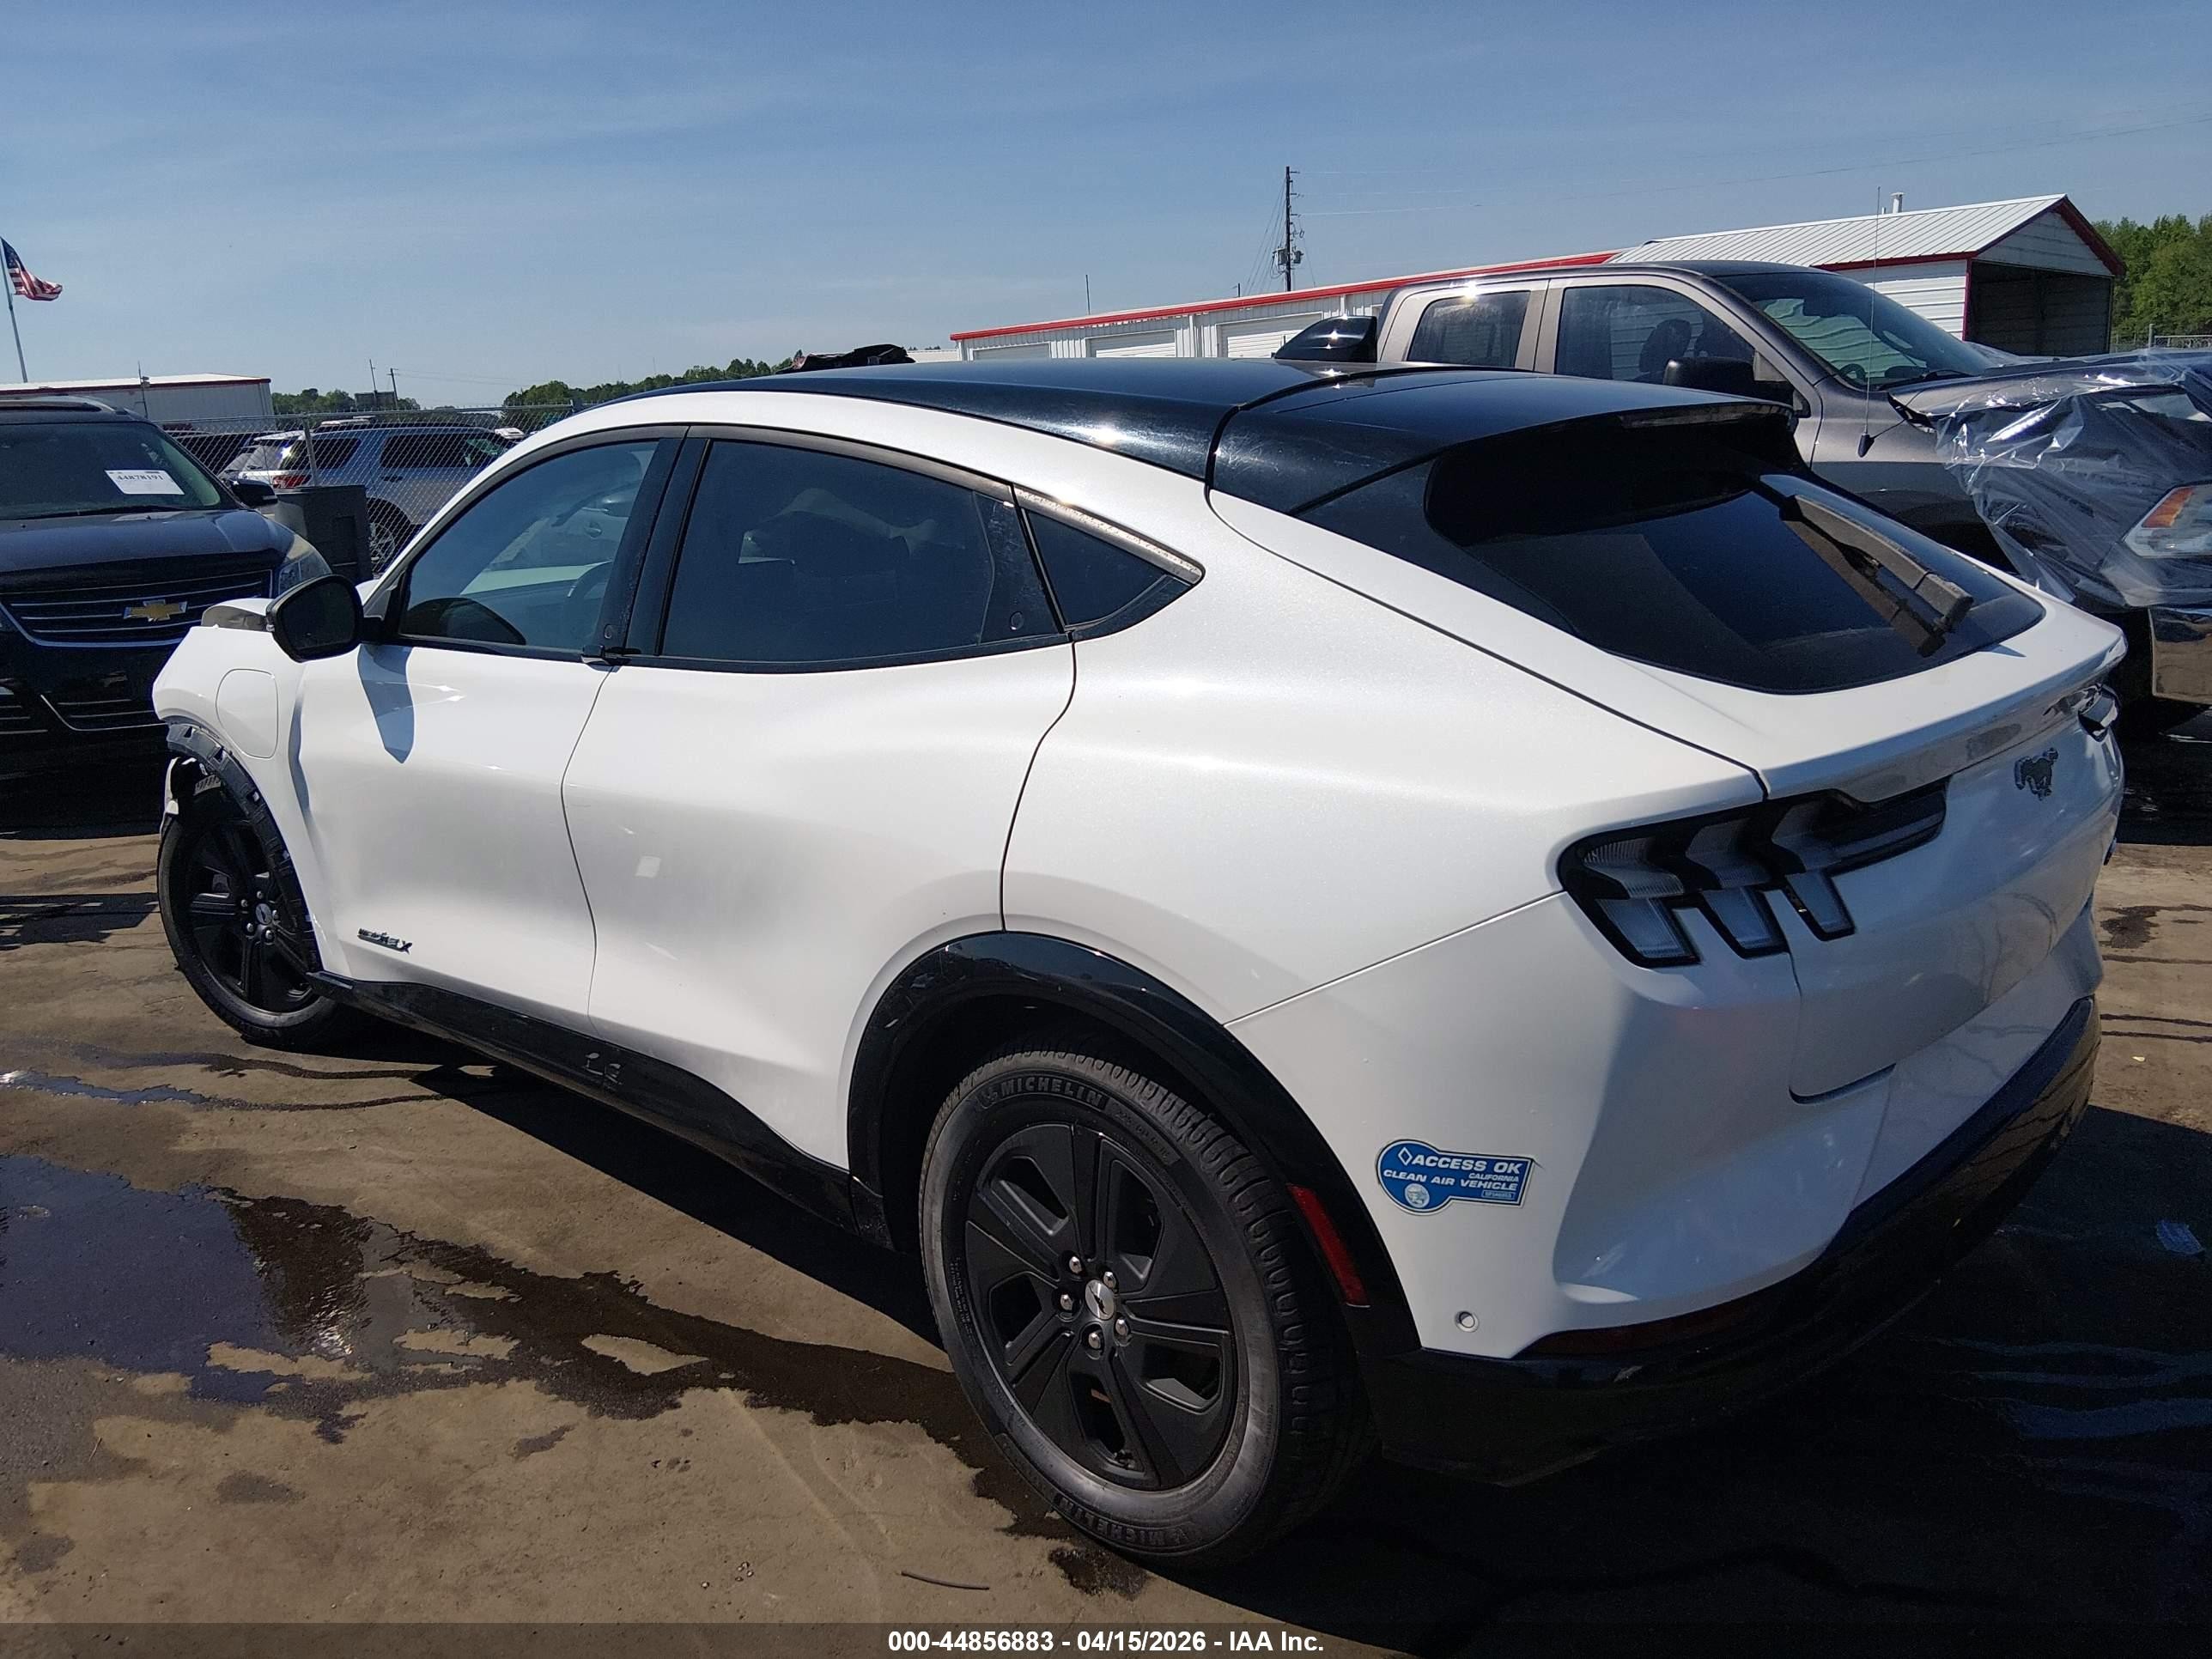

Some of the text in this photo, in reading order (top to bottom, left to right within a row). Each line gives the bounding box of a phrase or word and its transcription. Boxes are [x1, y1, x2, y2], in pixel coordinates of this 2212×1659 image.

[1001, 1077, 1103, 1107] MICHELIN
[1413, 1154, 1522, 1174] ACCESS OK
[1383, 1170, 1518, 1191] CLEAN AIR VEHICLE
[1468, 1173, 1519, 1182] CALIFORNIA
[1056, 1497, 1164, 1545] MICHELIN
